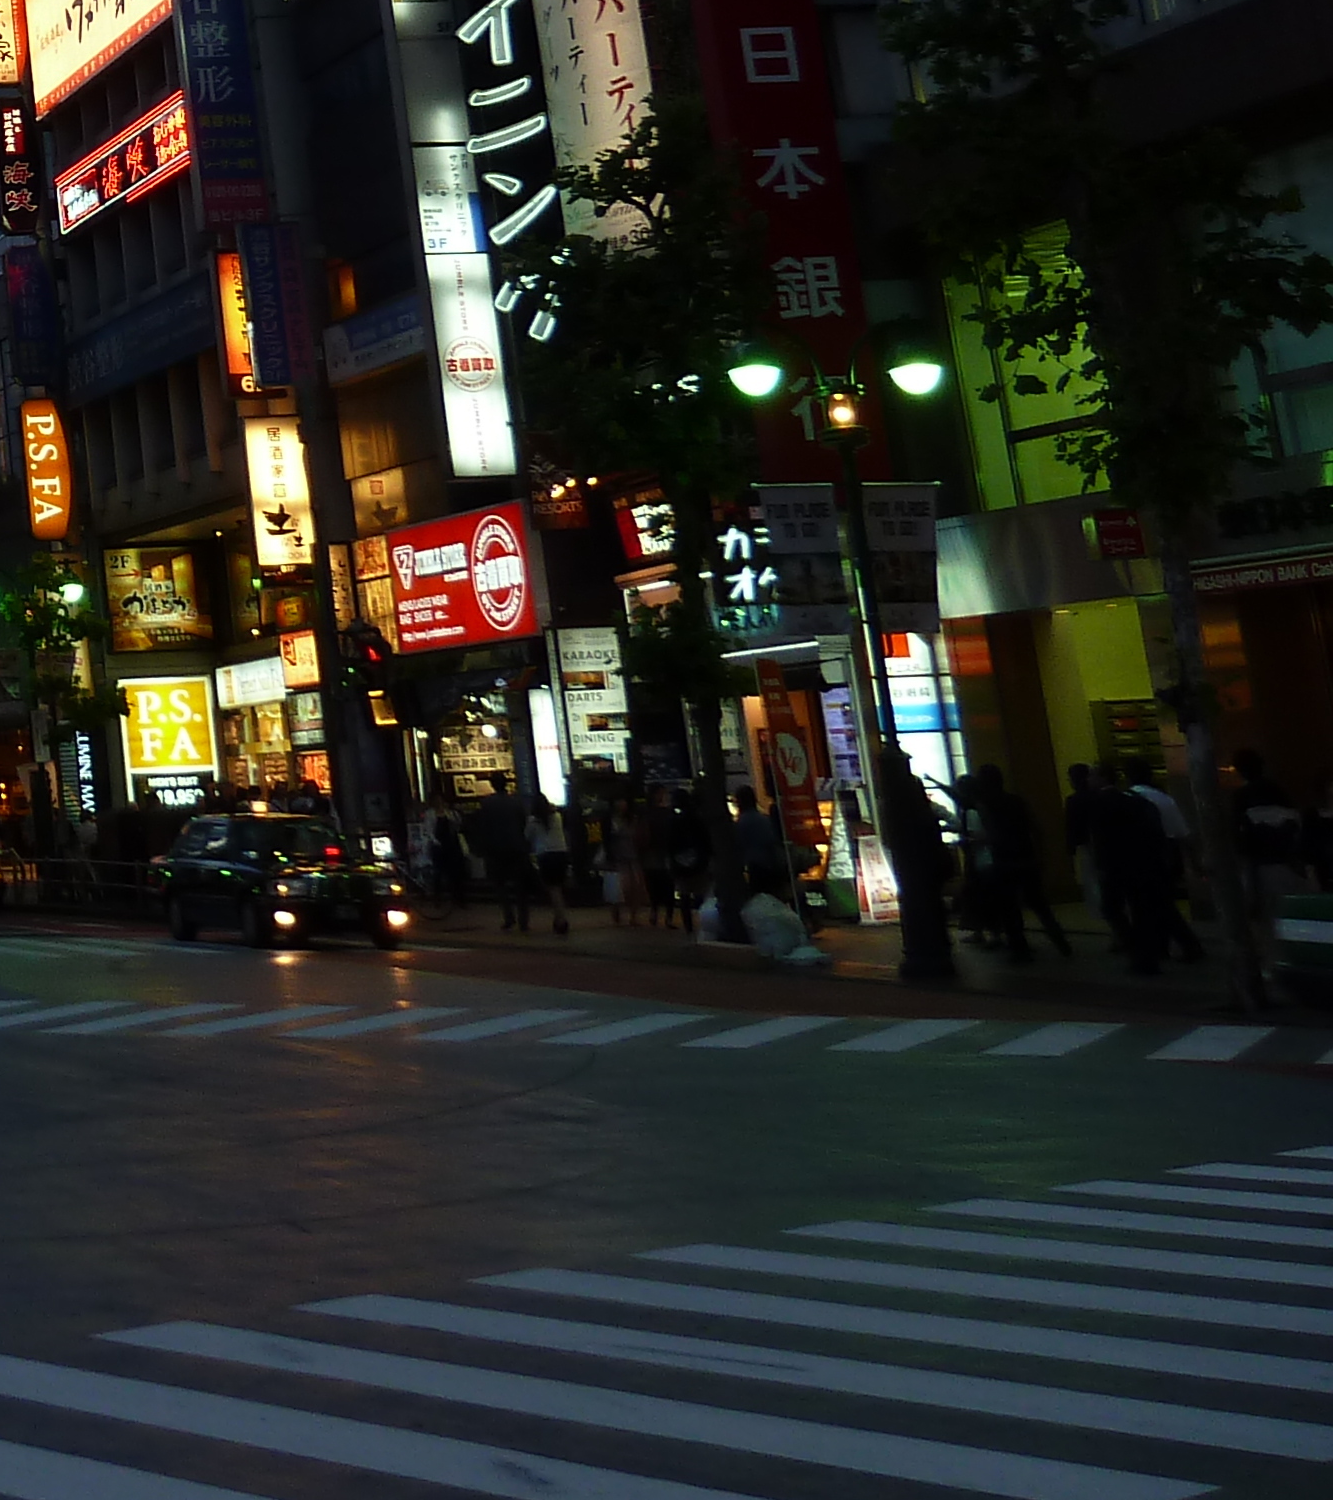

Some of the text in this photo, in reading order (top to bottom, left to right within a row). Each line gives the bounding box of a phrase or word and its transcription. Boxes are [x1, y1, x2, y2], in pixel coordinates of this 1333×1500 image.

[426, 237, 448, 249] 3F
[110, 554, 131, 569] 2F
[1192, 567, 1275, 592] HIGASHI-NIPPON
[1276, 563, 1309, 582] BANK
[561, 648, 618, 661] KARAOKE
[567, 691, 603, 703] DARTS
[134, 688, 203, 725] P.S.
[572, 732, 615, 744] DINING
[74, 730, 94, 782] LUMINE
